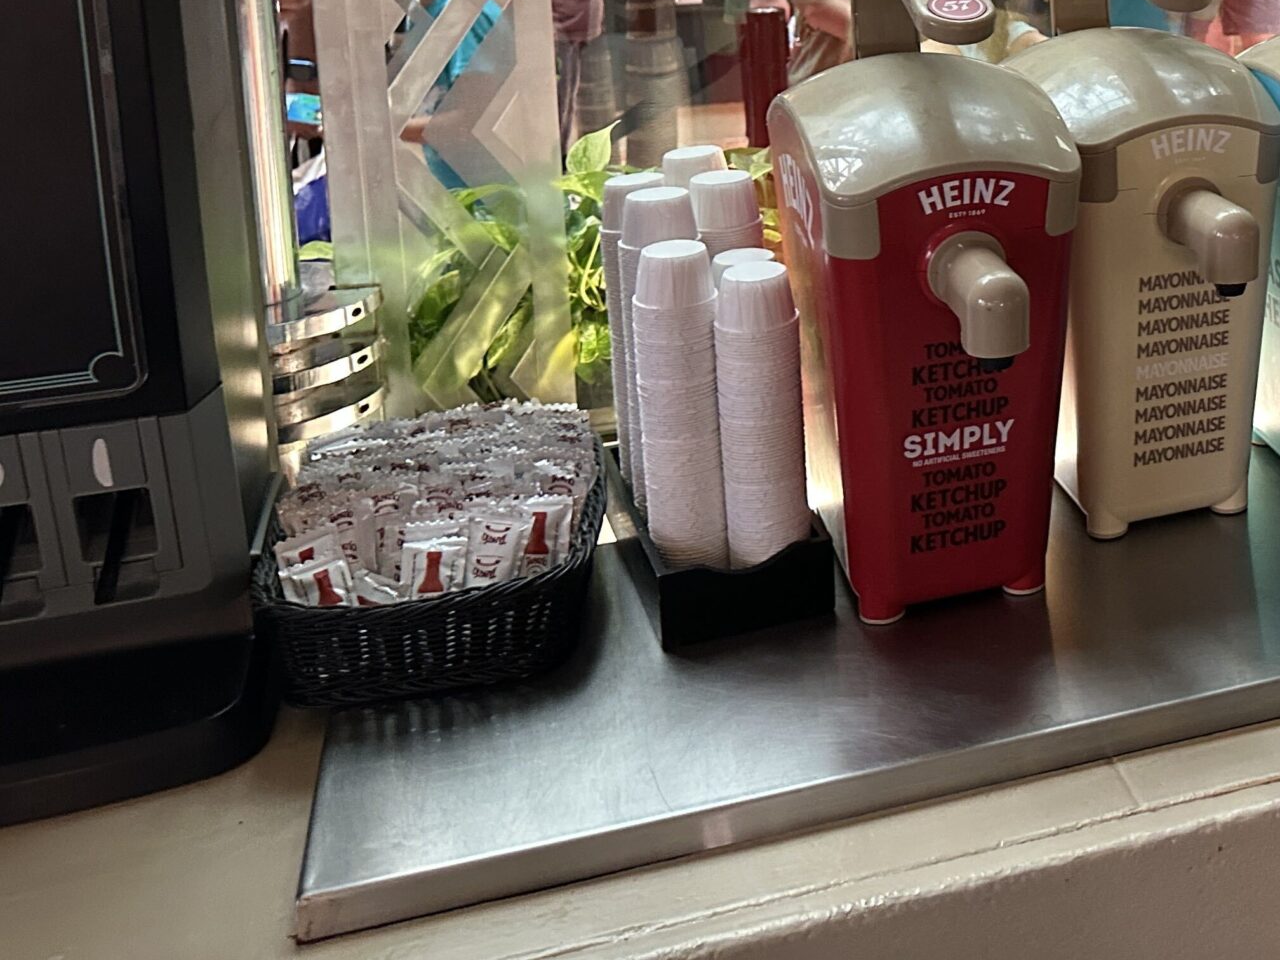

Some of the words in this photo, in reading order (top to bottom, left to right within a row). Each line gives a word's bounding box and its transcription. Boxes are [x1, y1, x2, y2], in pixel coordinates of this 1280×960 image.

[942, 0, 973, 12] 57
[1150, 127, 1232, 160] HEINZ
[917, 177, 1016, 215] HEINZ
[1139, 270, 1205, 294] MAYONN
[1137, 308, 1230, 337] MAYONNAISE
[923, 341, 966, 359] TOM
[1136, 330, 1229, 359] MAYONNAISE
[911, 359, 1004, 387] KETCH
[1136, 352, 1229, 380] MAYONNAISE
[923, 378, 998, 403] TOMATO
[1135, 373, 1227, 403] MAYONNAISE
[911, 396, 1009, 429] KETCHUP
[1134, 394, 1227, 424] MAYONNAISE
[903, 419, 1015, 459] SIMPLY
[1134, 415, 1226, 446] MAYONNAISE
[912, 458, 923, 468] NO
[923, 452, 960, 466] ARTIFICIAL
[961, 445, 1006, 460] SWEETENERS
[1133, 436, 1225, 467] MAYONNAISE
[922, 461, 997, 488] TOMATO
[911, 478, 1008, 513] KETCHUP
[921, 502, 996, 529] TOMATO
[910, 519, 1006, 554] KETCHUP
